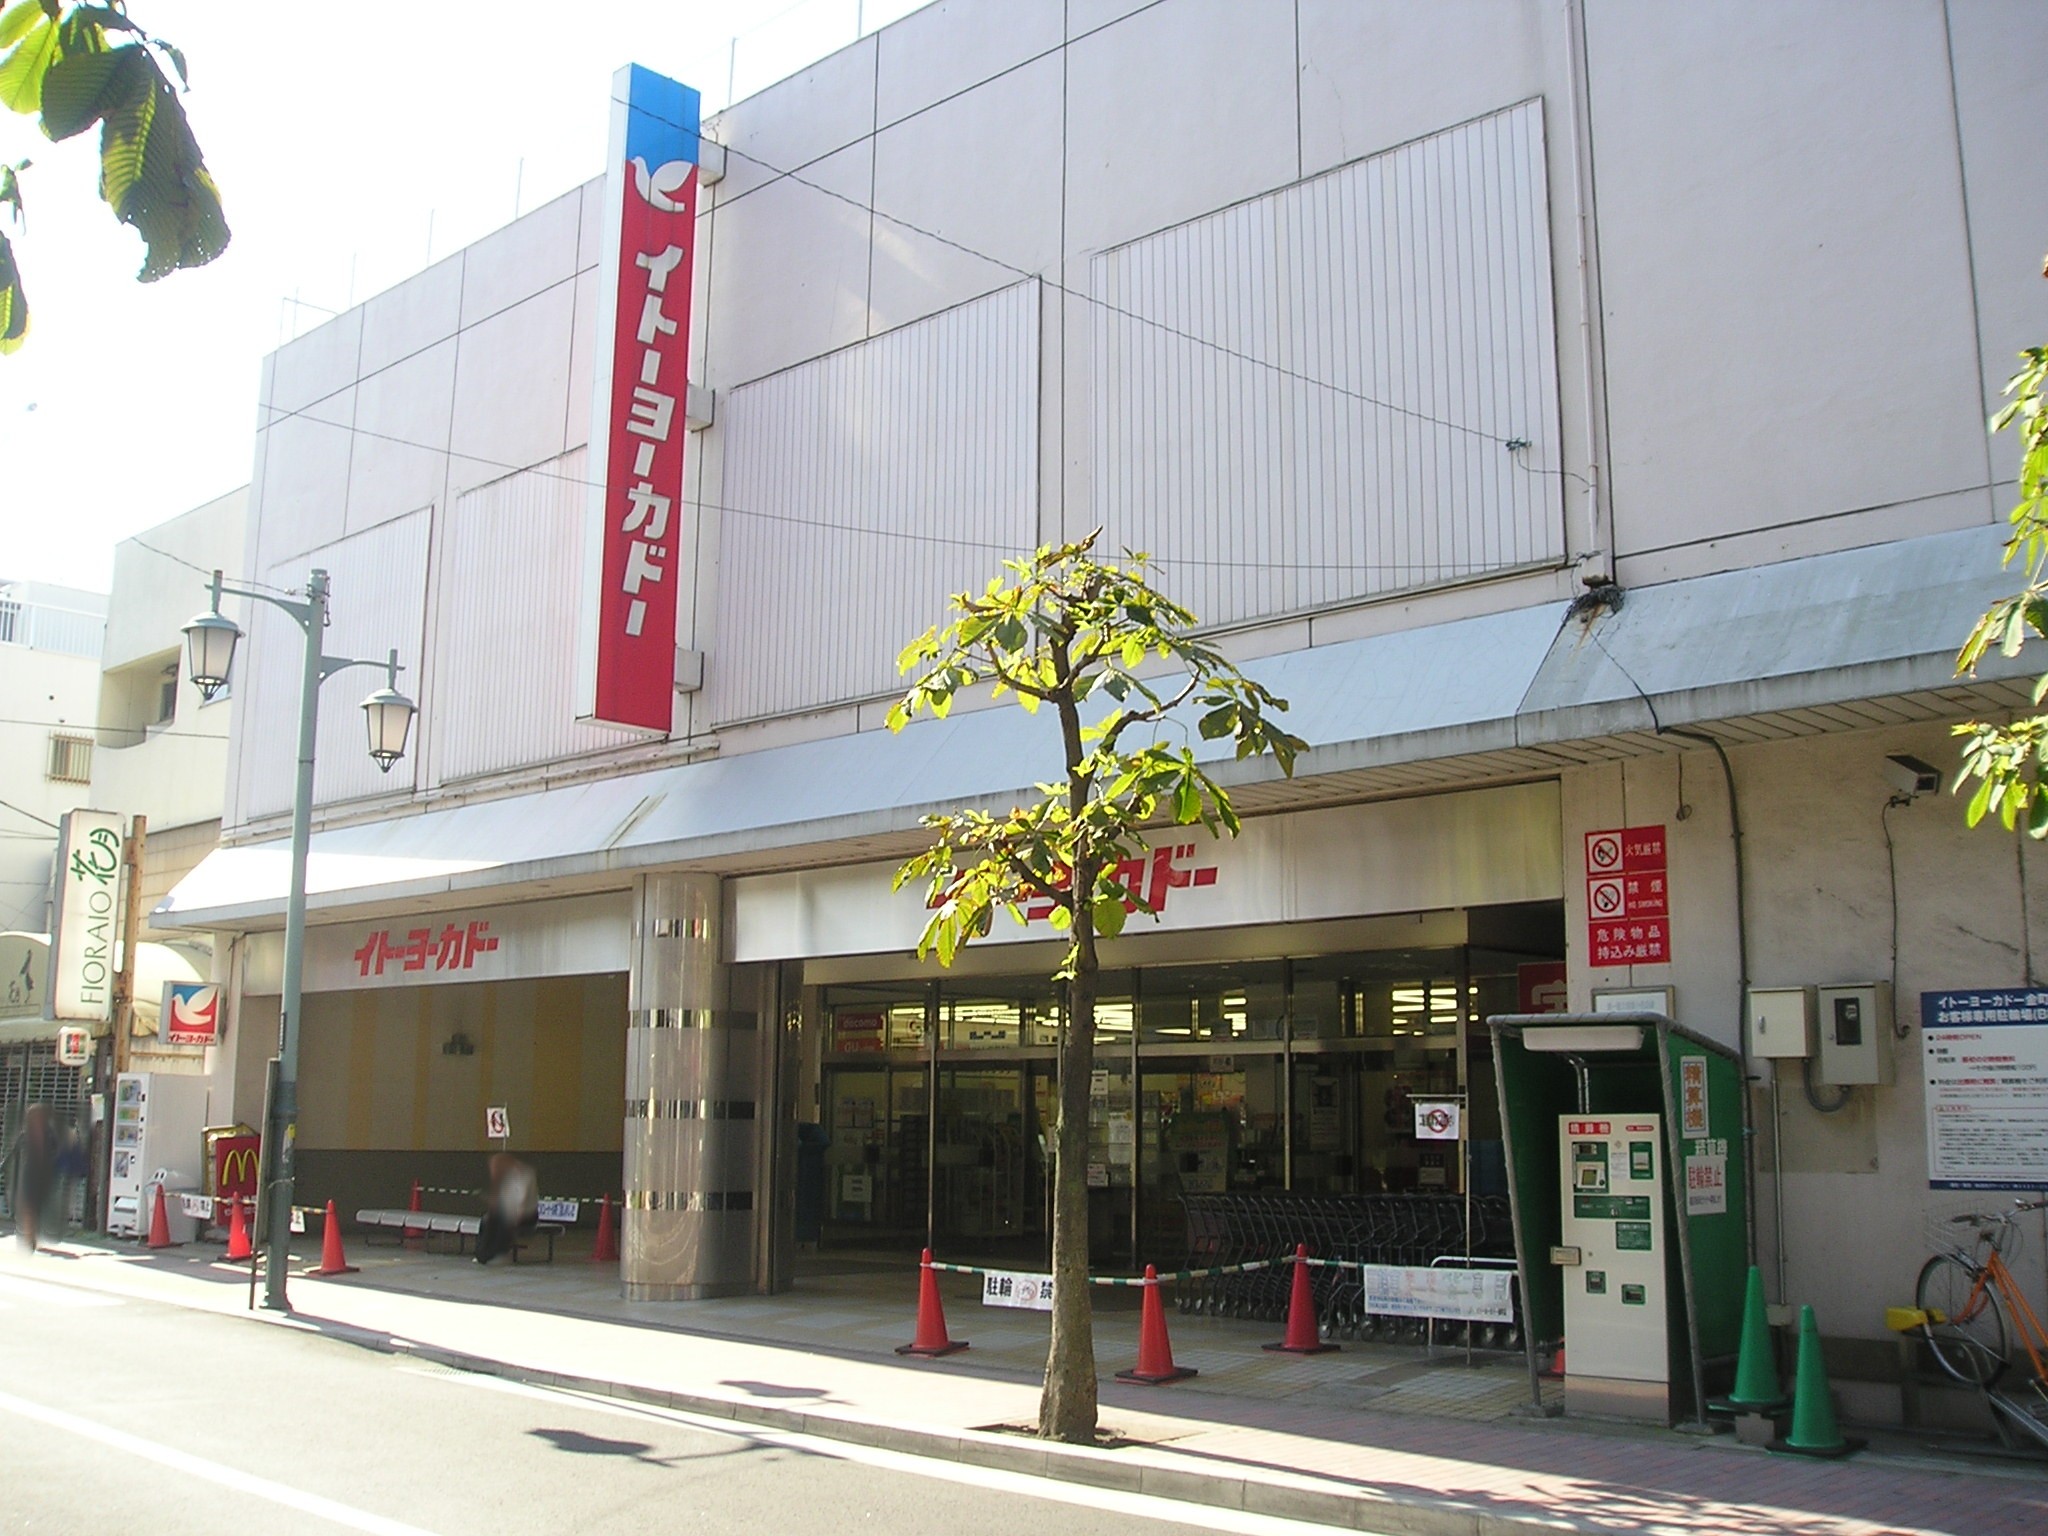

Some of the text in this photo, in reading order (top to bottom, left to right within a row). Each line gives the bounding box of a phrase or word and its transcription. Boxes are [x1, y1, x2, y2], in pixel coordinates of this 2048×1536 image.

[622, 243, 684, 638] イトーヨーカドー
[1625, 842, 1661, 857] 火気厳禁
[1628, 879, 1662, 894] 禁煙
[1597, 925, 1660, 942] 危険物品
[81, 891, 111, 1004] FIORAIO
[354, 921, 498, 976] イトーヨーカドー
[1598, 942, 1661, 960] 持込み厳禁
[986, 1277, 1012, 1297] 駐輪
